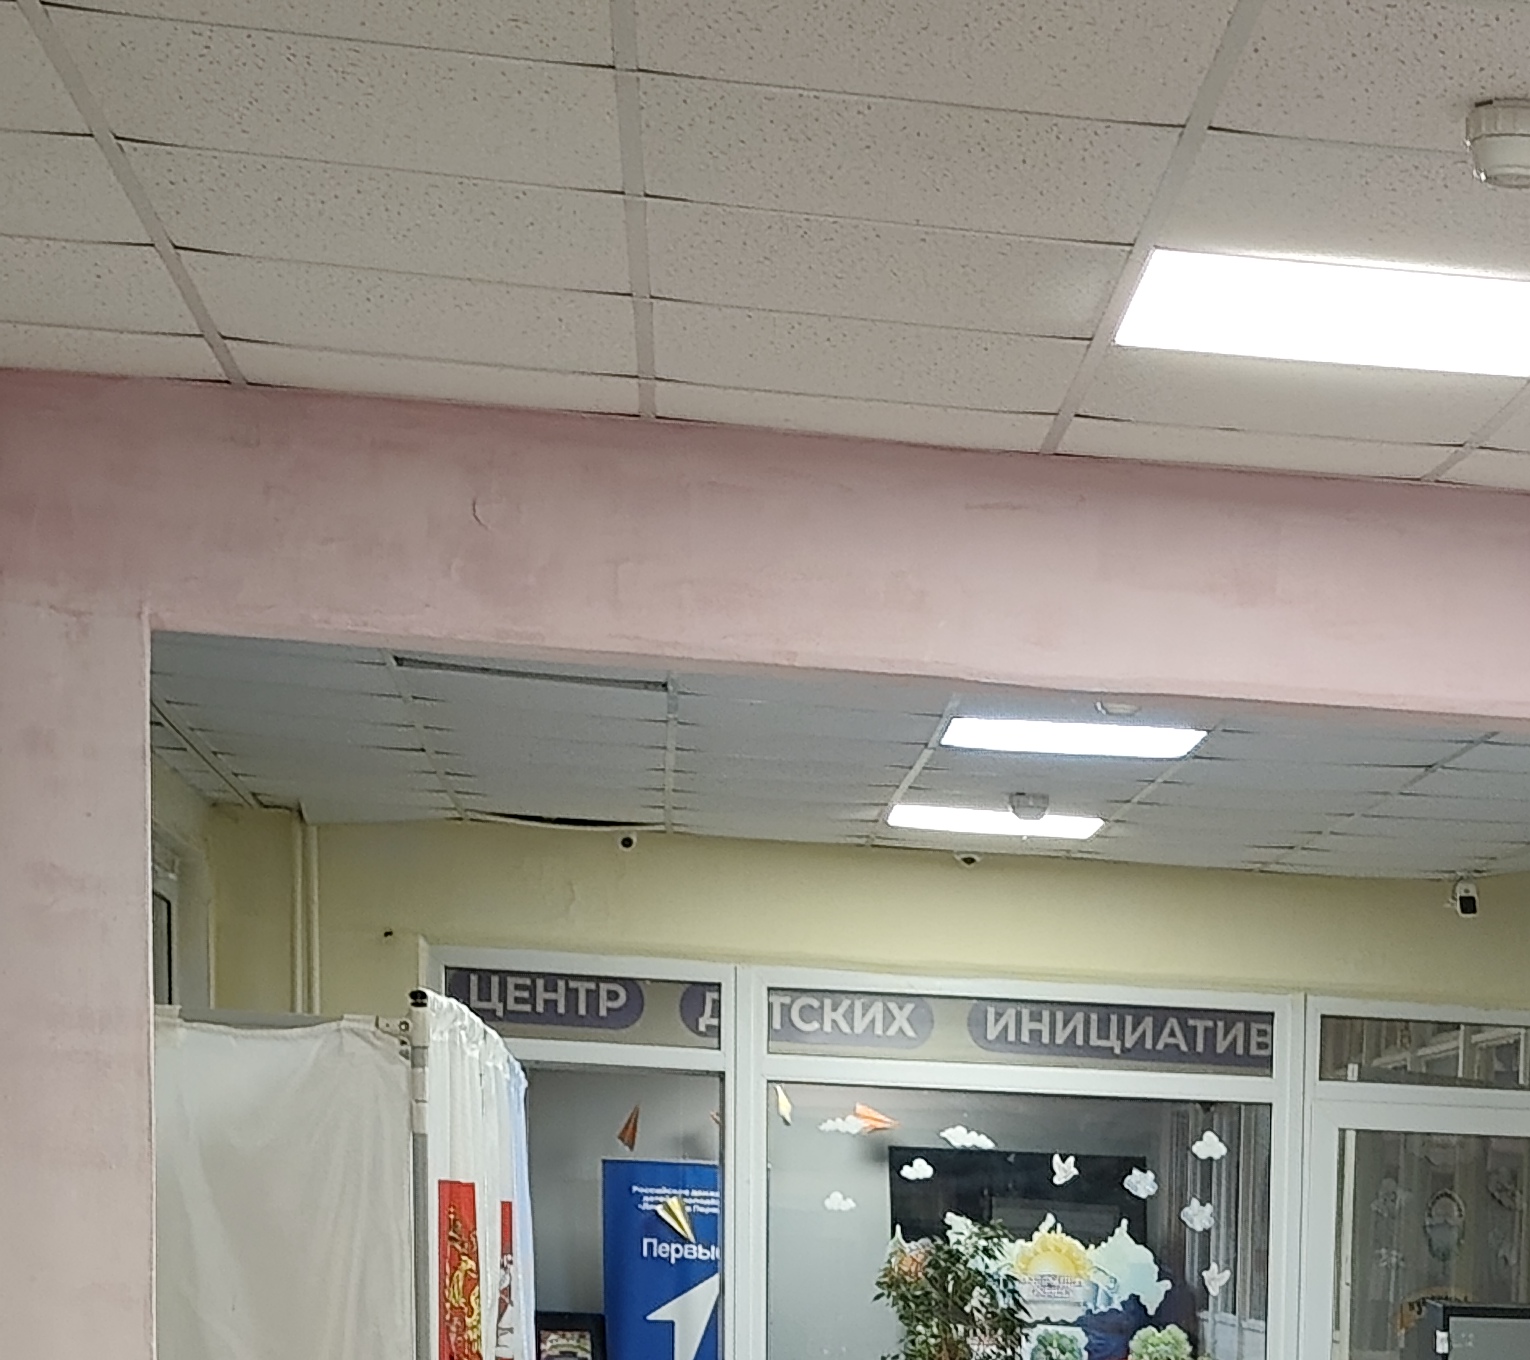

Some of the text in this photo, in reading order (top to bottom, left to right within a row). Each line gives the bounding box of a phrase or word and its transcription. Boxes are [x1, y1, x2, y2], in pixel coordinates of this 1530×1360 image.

[469, 973, 1272, 1056] ЦЕНТР ДТСКИХ ИНИЦИАТИВ
